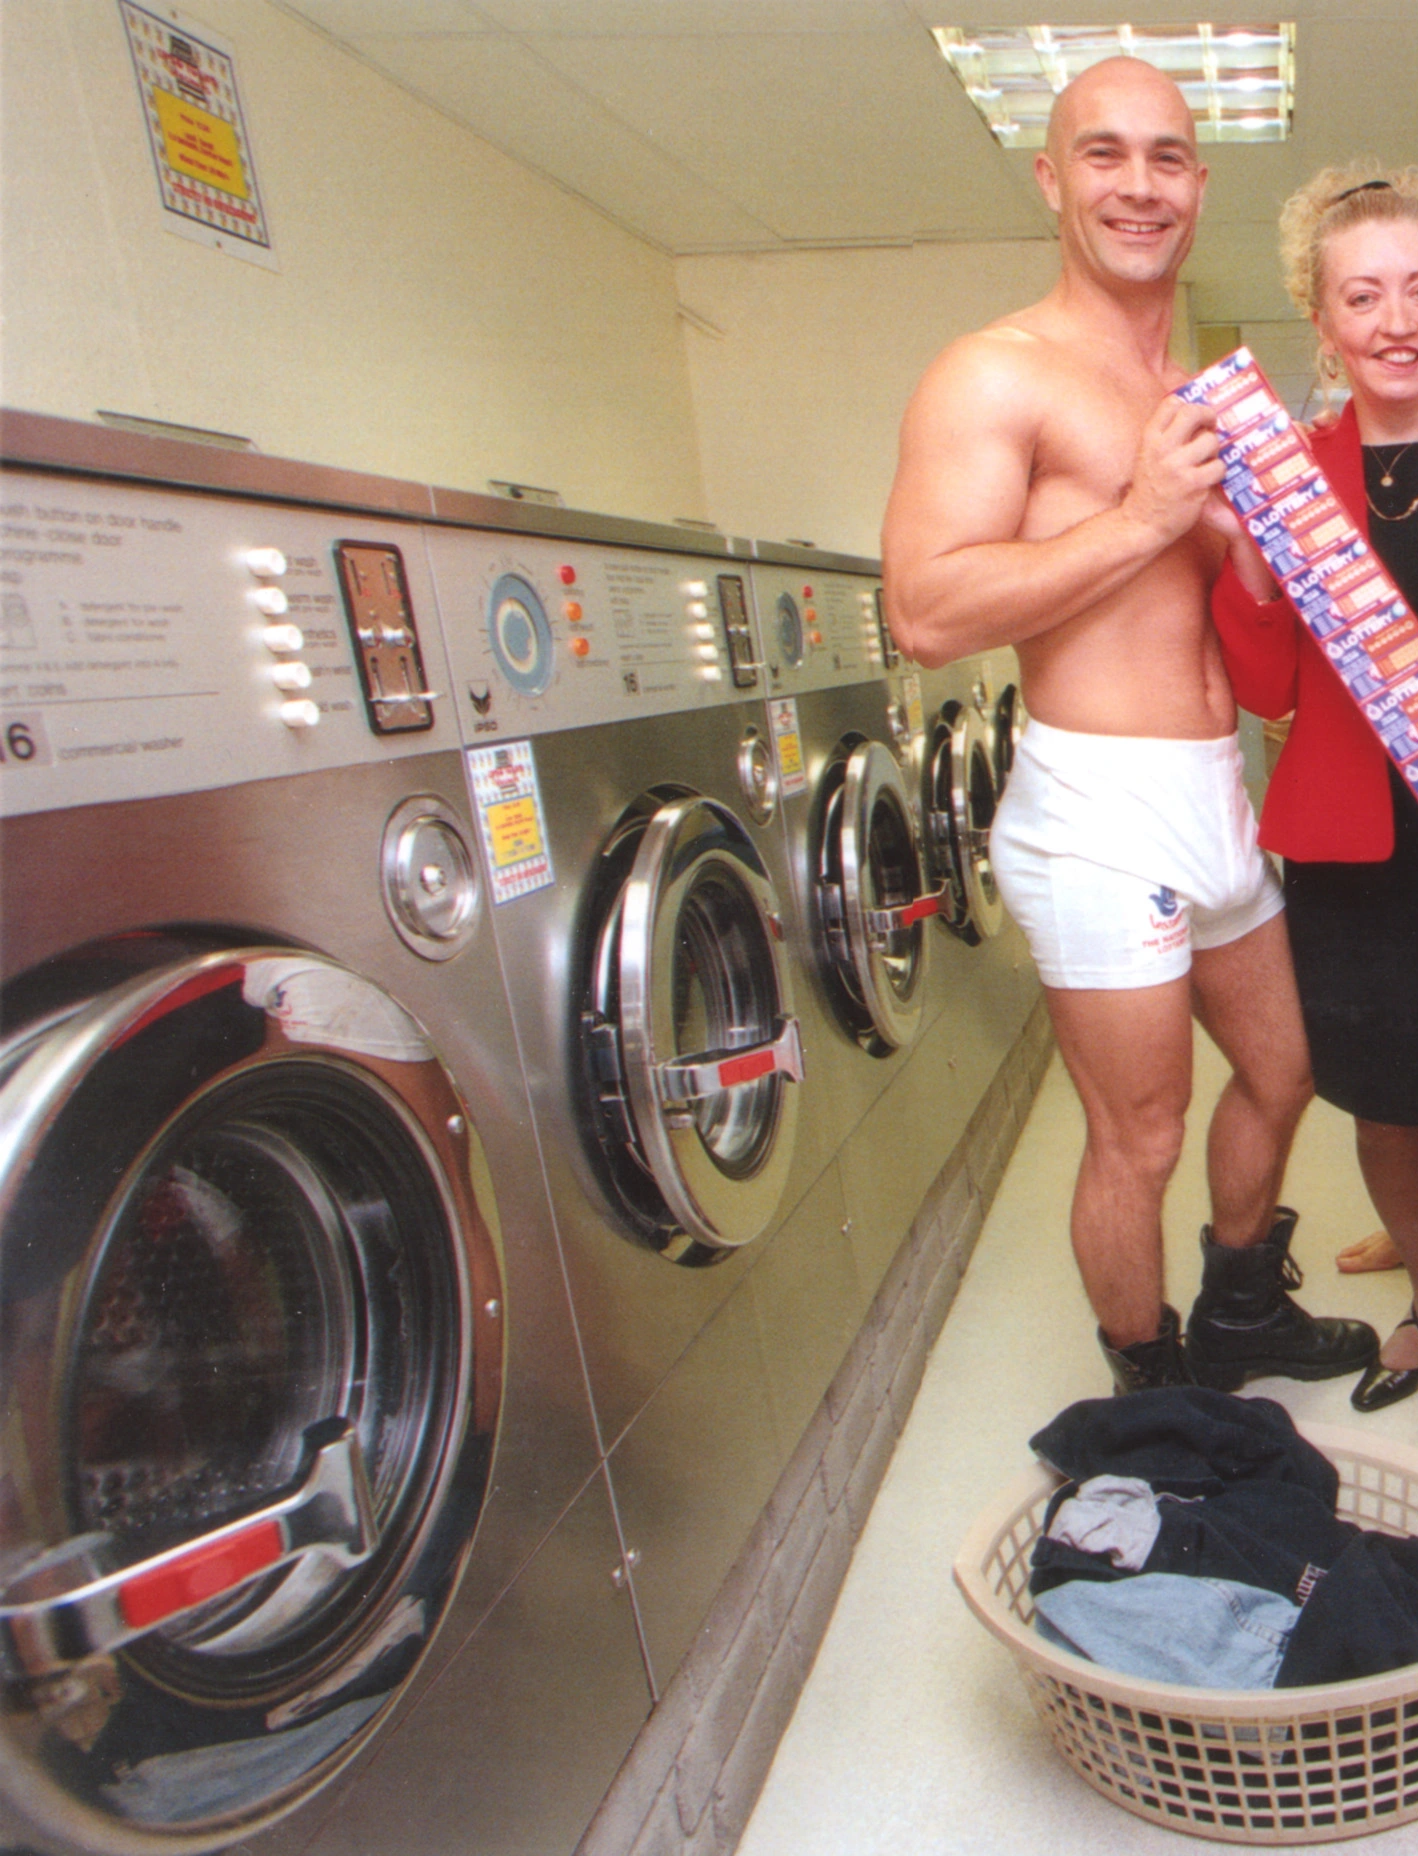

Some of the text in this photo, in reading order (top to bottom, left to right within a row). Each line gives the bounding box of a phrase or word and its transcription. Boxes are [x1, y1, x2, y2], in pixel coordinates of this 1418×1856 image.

[1184, 363, 1238, 403] LOTTERY
[1223, 427, 1276, 464] LOTTERY
[1261, 488, 1316, 526] LOTTERY
[1301, 551, 1355, 588] LOTTERY
[1340, 610, 1395, 650] LOTTERY
